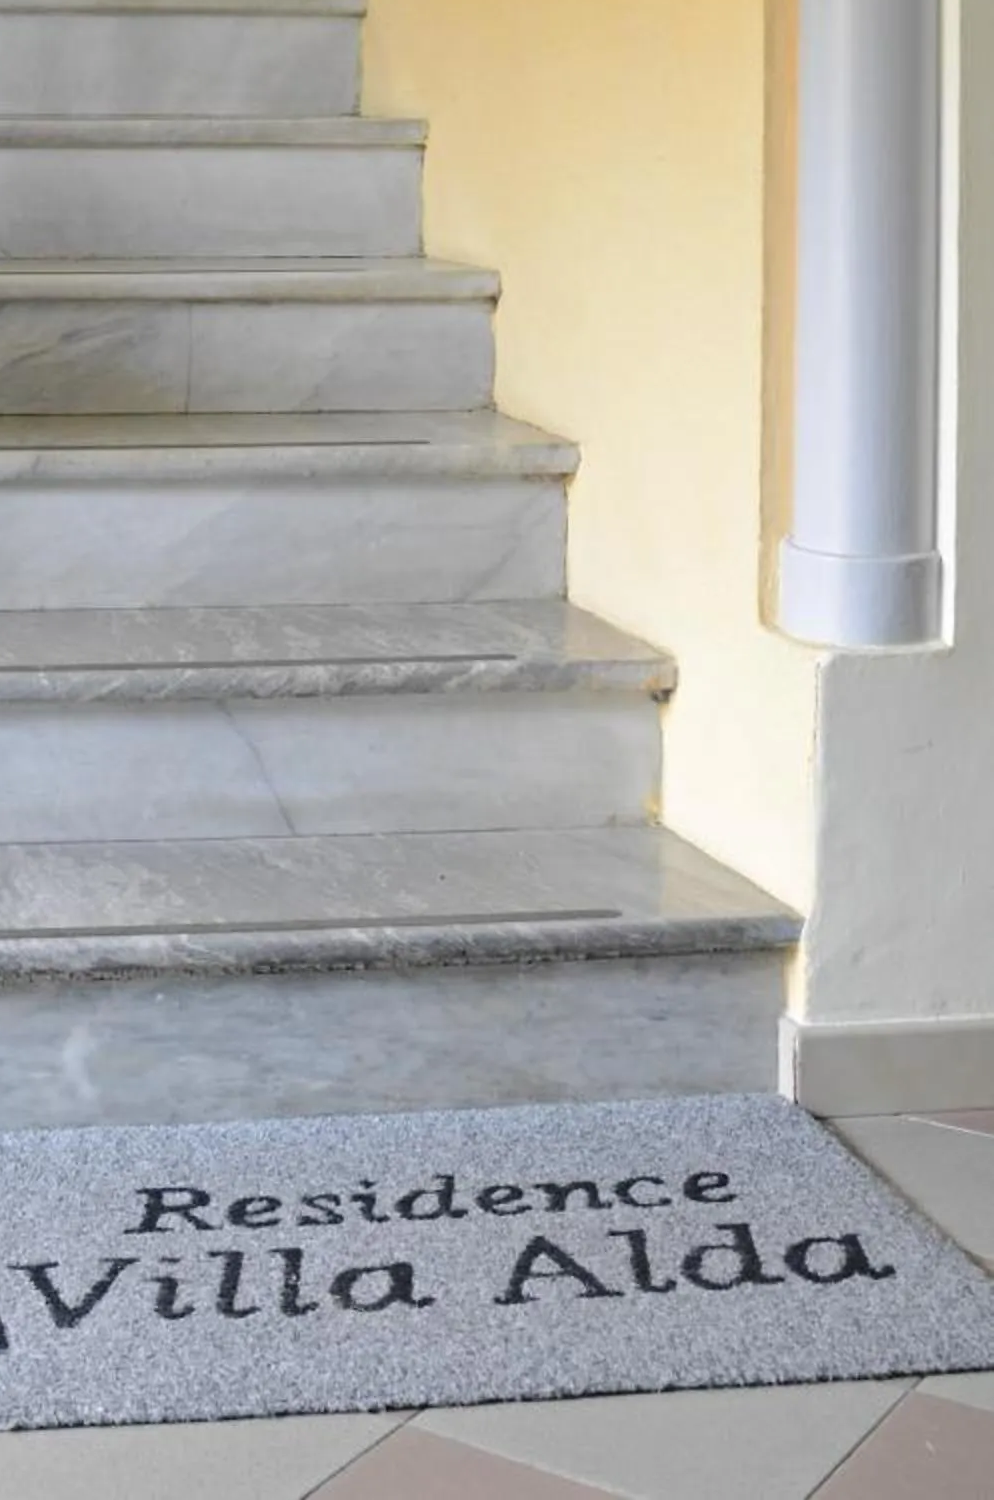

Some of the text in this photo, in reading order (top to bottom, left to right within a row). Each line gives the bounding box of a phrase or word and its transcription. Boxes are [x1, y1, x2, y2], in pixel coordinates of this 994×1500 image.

[123, 1171, 736, 1234] Residence
[7, 1222, 896, 1329] Villa Alda
